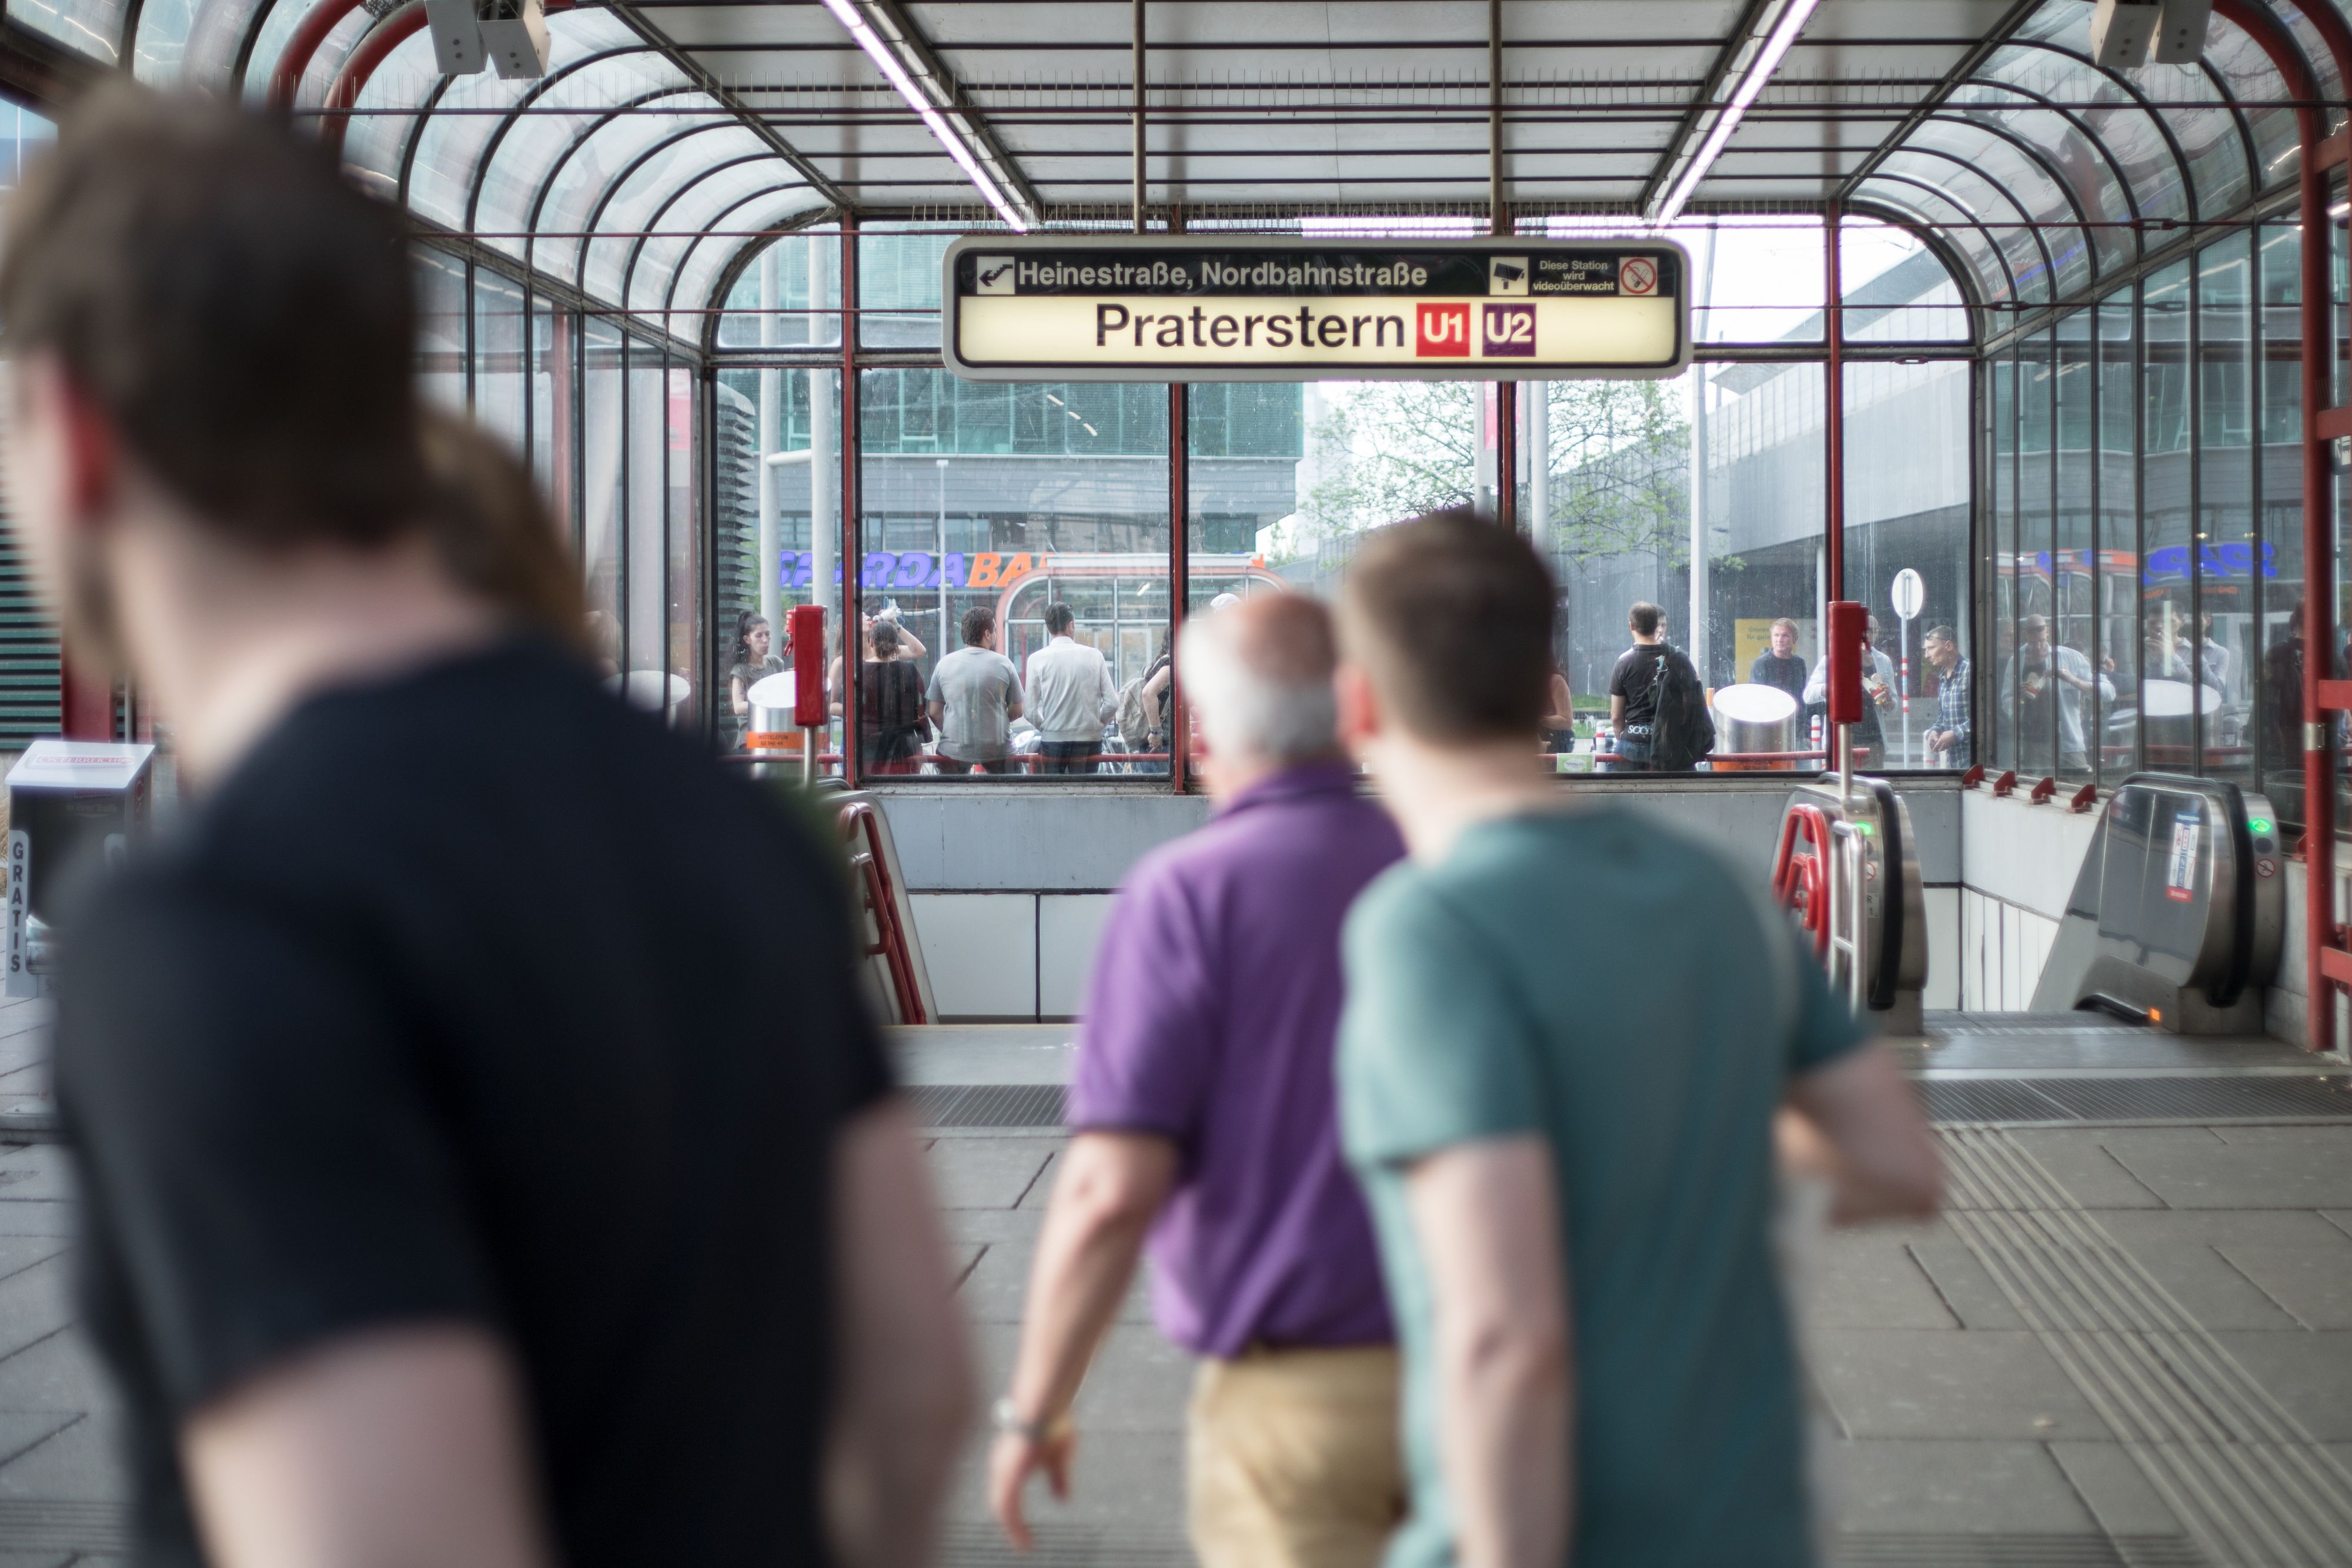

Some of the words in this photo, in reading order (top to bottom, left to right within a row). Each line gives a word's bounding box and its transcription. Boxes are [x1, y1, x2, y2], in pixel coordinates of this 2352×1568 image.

[1539, 260, 1568, 270] Diese
[1572, 260, 1608, 270] Station
[1019, 262, 1193, 290] Heinestraße,
[1202, 262, 1427, 286] Nordbahnstraße
[1563, 271, 1586, 280] wird
[1533, 281, 1615, 291] videoüberwacht
[1096, 303, 1405, 347] Praterstern
[1424, 312, 1462, 343] U1
[1487, 312, 1532, 343] U2
[10, 841, 24, 973] GRATIS
